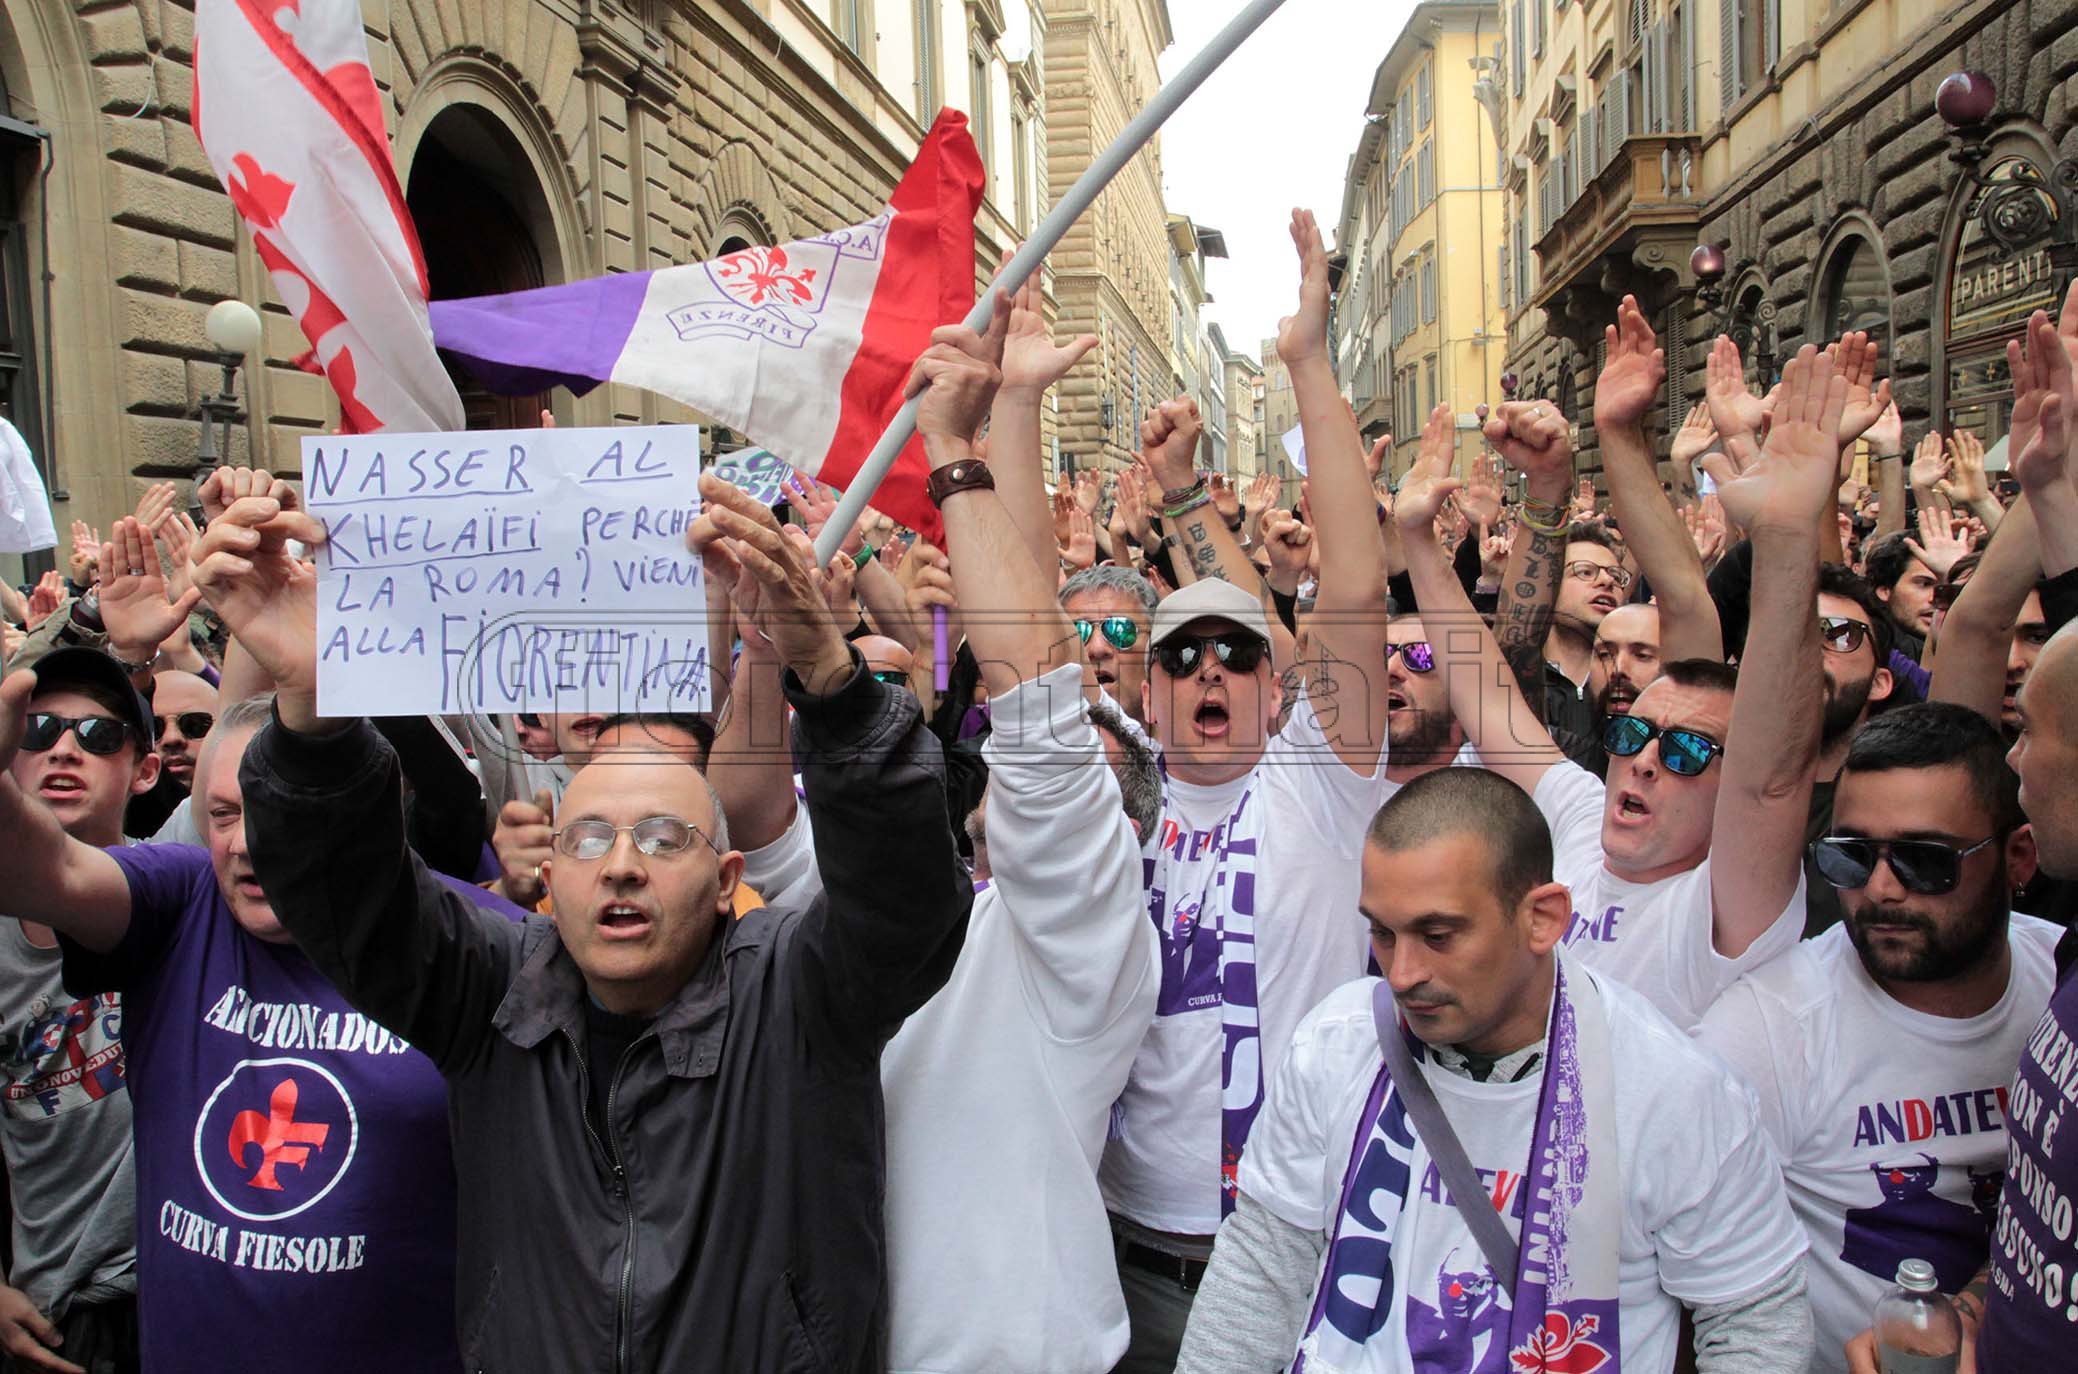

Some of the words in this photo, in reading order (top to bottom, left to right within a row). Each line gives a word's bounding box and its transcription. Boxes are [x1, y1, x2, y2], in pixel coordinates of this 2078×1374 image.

[309, 444, 530, 500] NASSER
[587, 440, 668, 479] AL
[336, 573, 395, 613] LA
[423, 547, 592, 603] ROMA?
[613, 555, 700, 592] VIENI
[322, 625, 426, 662] ALLA
[1187, 993, 1217, 1007] CURVA
[159, 1199, 229, 1263] CURVA
[233, 1225, 367, 1274] FIESOLE
